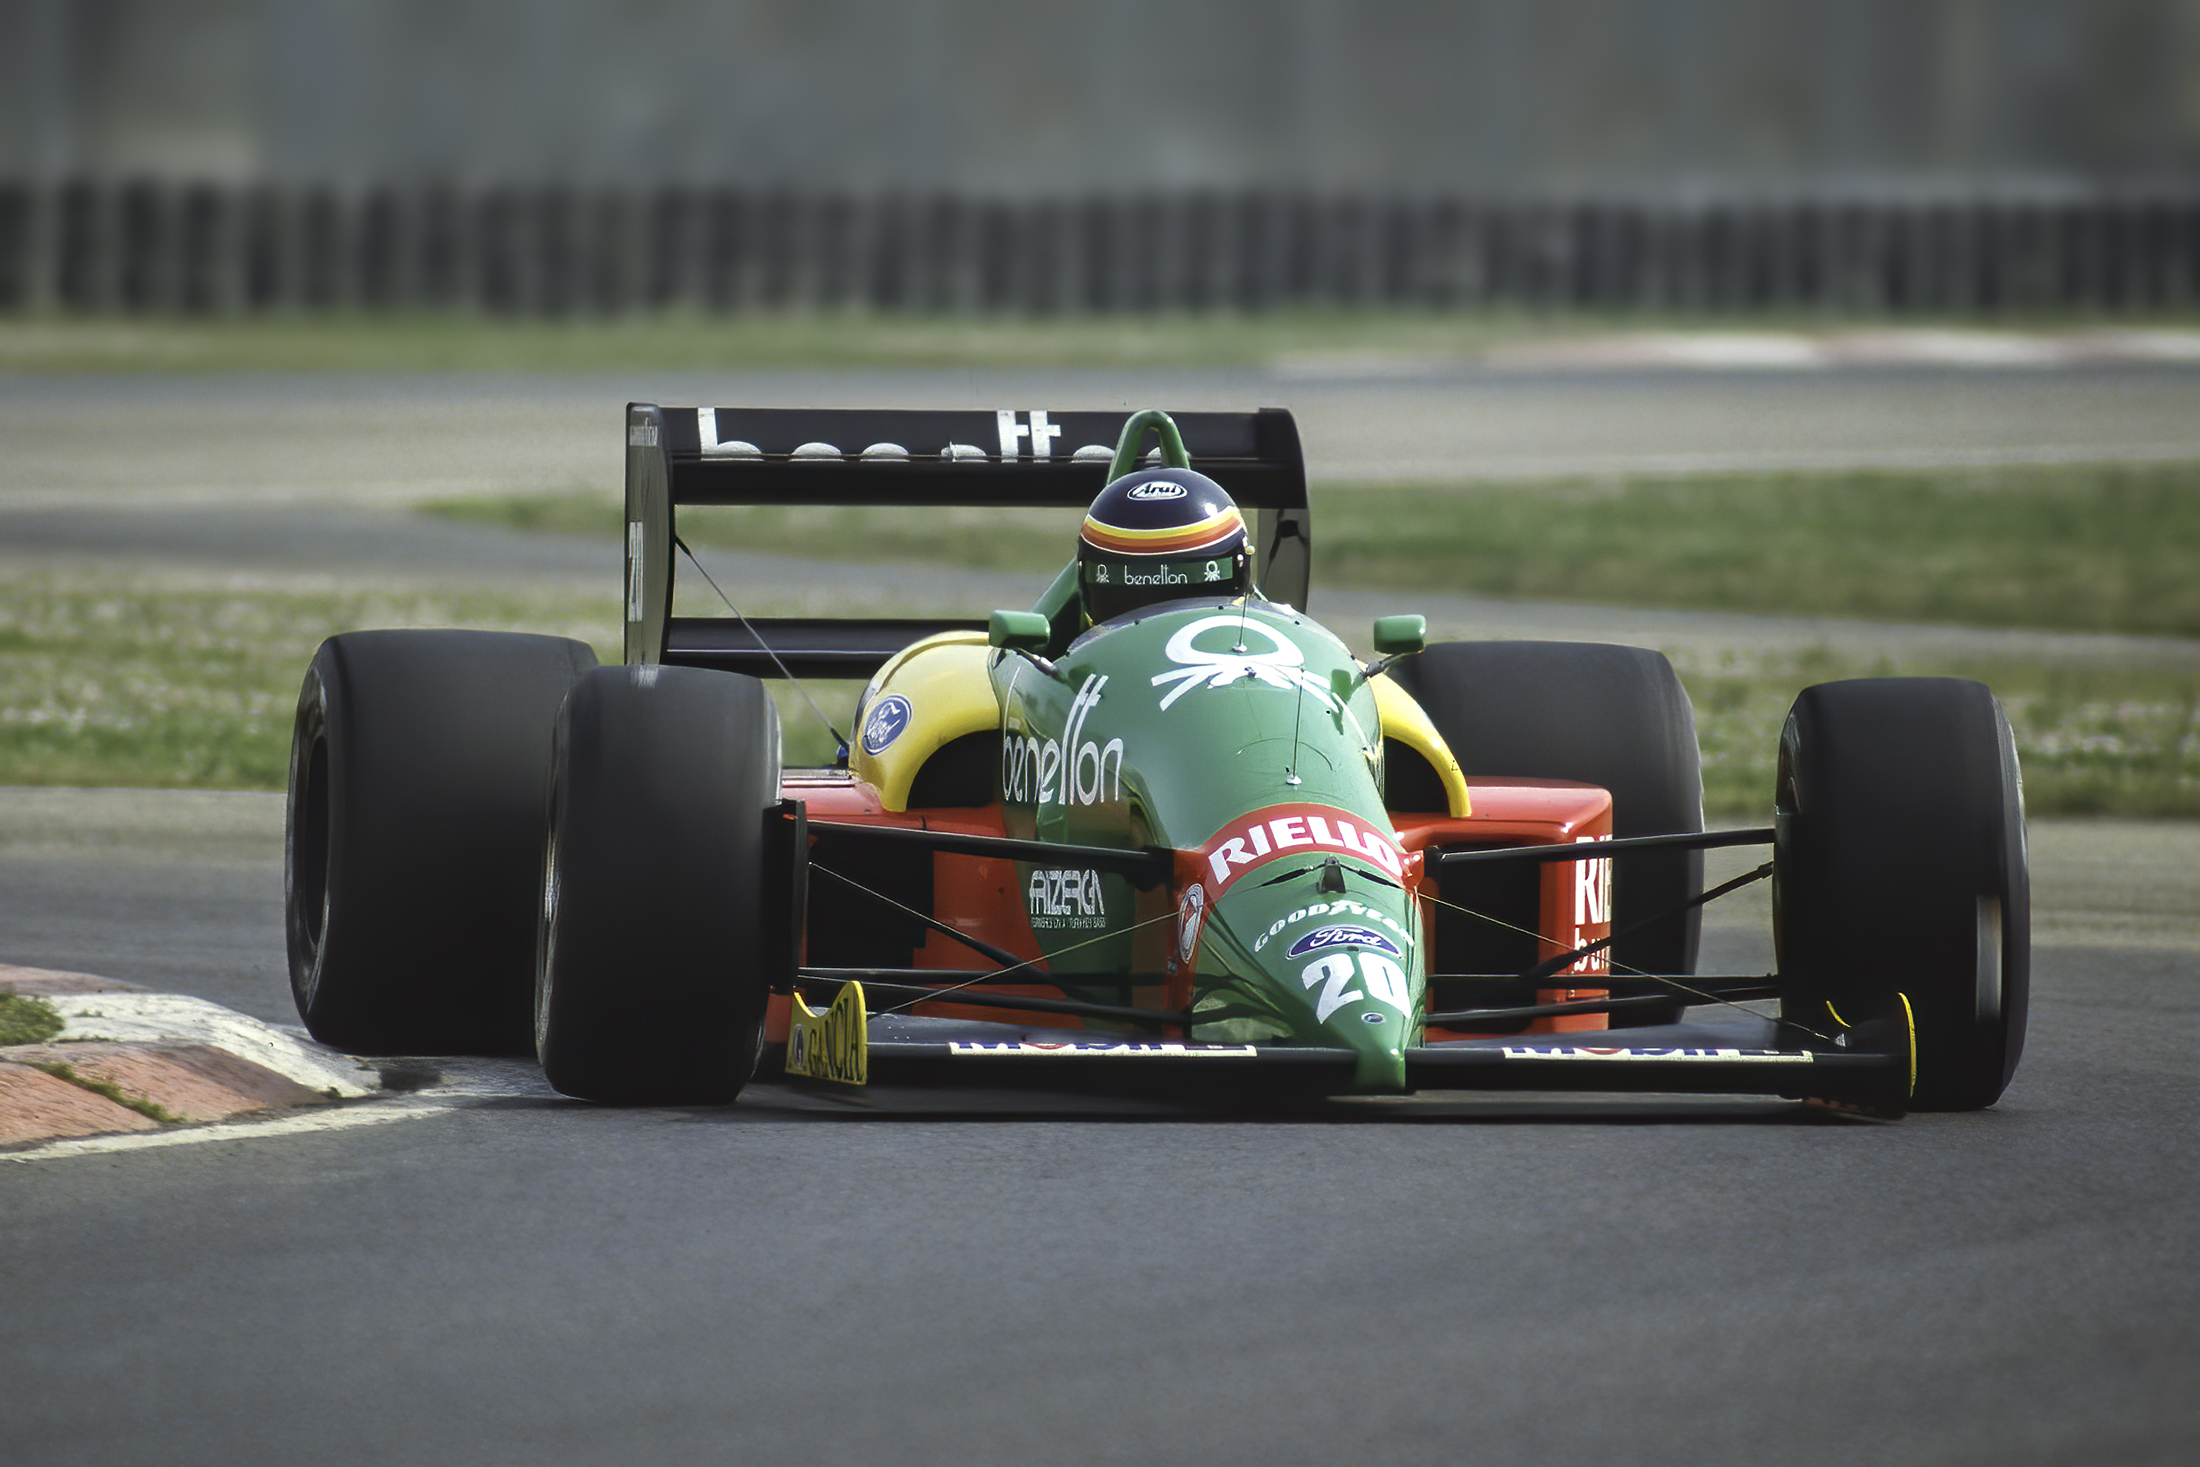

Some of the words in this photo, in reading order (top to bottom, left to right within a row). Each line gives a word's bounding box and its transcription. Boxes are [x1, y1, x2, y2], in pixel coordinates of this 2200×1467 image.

[1133, 483, 1177, 497] Arai
[1124, 564, 1188, 585] benetton
[1002, 665, 1124, 806] benetton
[1208, 816, 1402, 885] RIELLO
[1254, 899, 1415, 953] GOODYEAR
[1310, 927, 1382, 948] Ford
[1301, 952, 1412, 1025] 20
